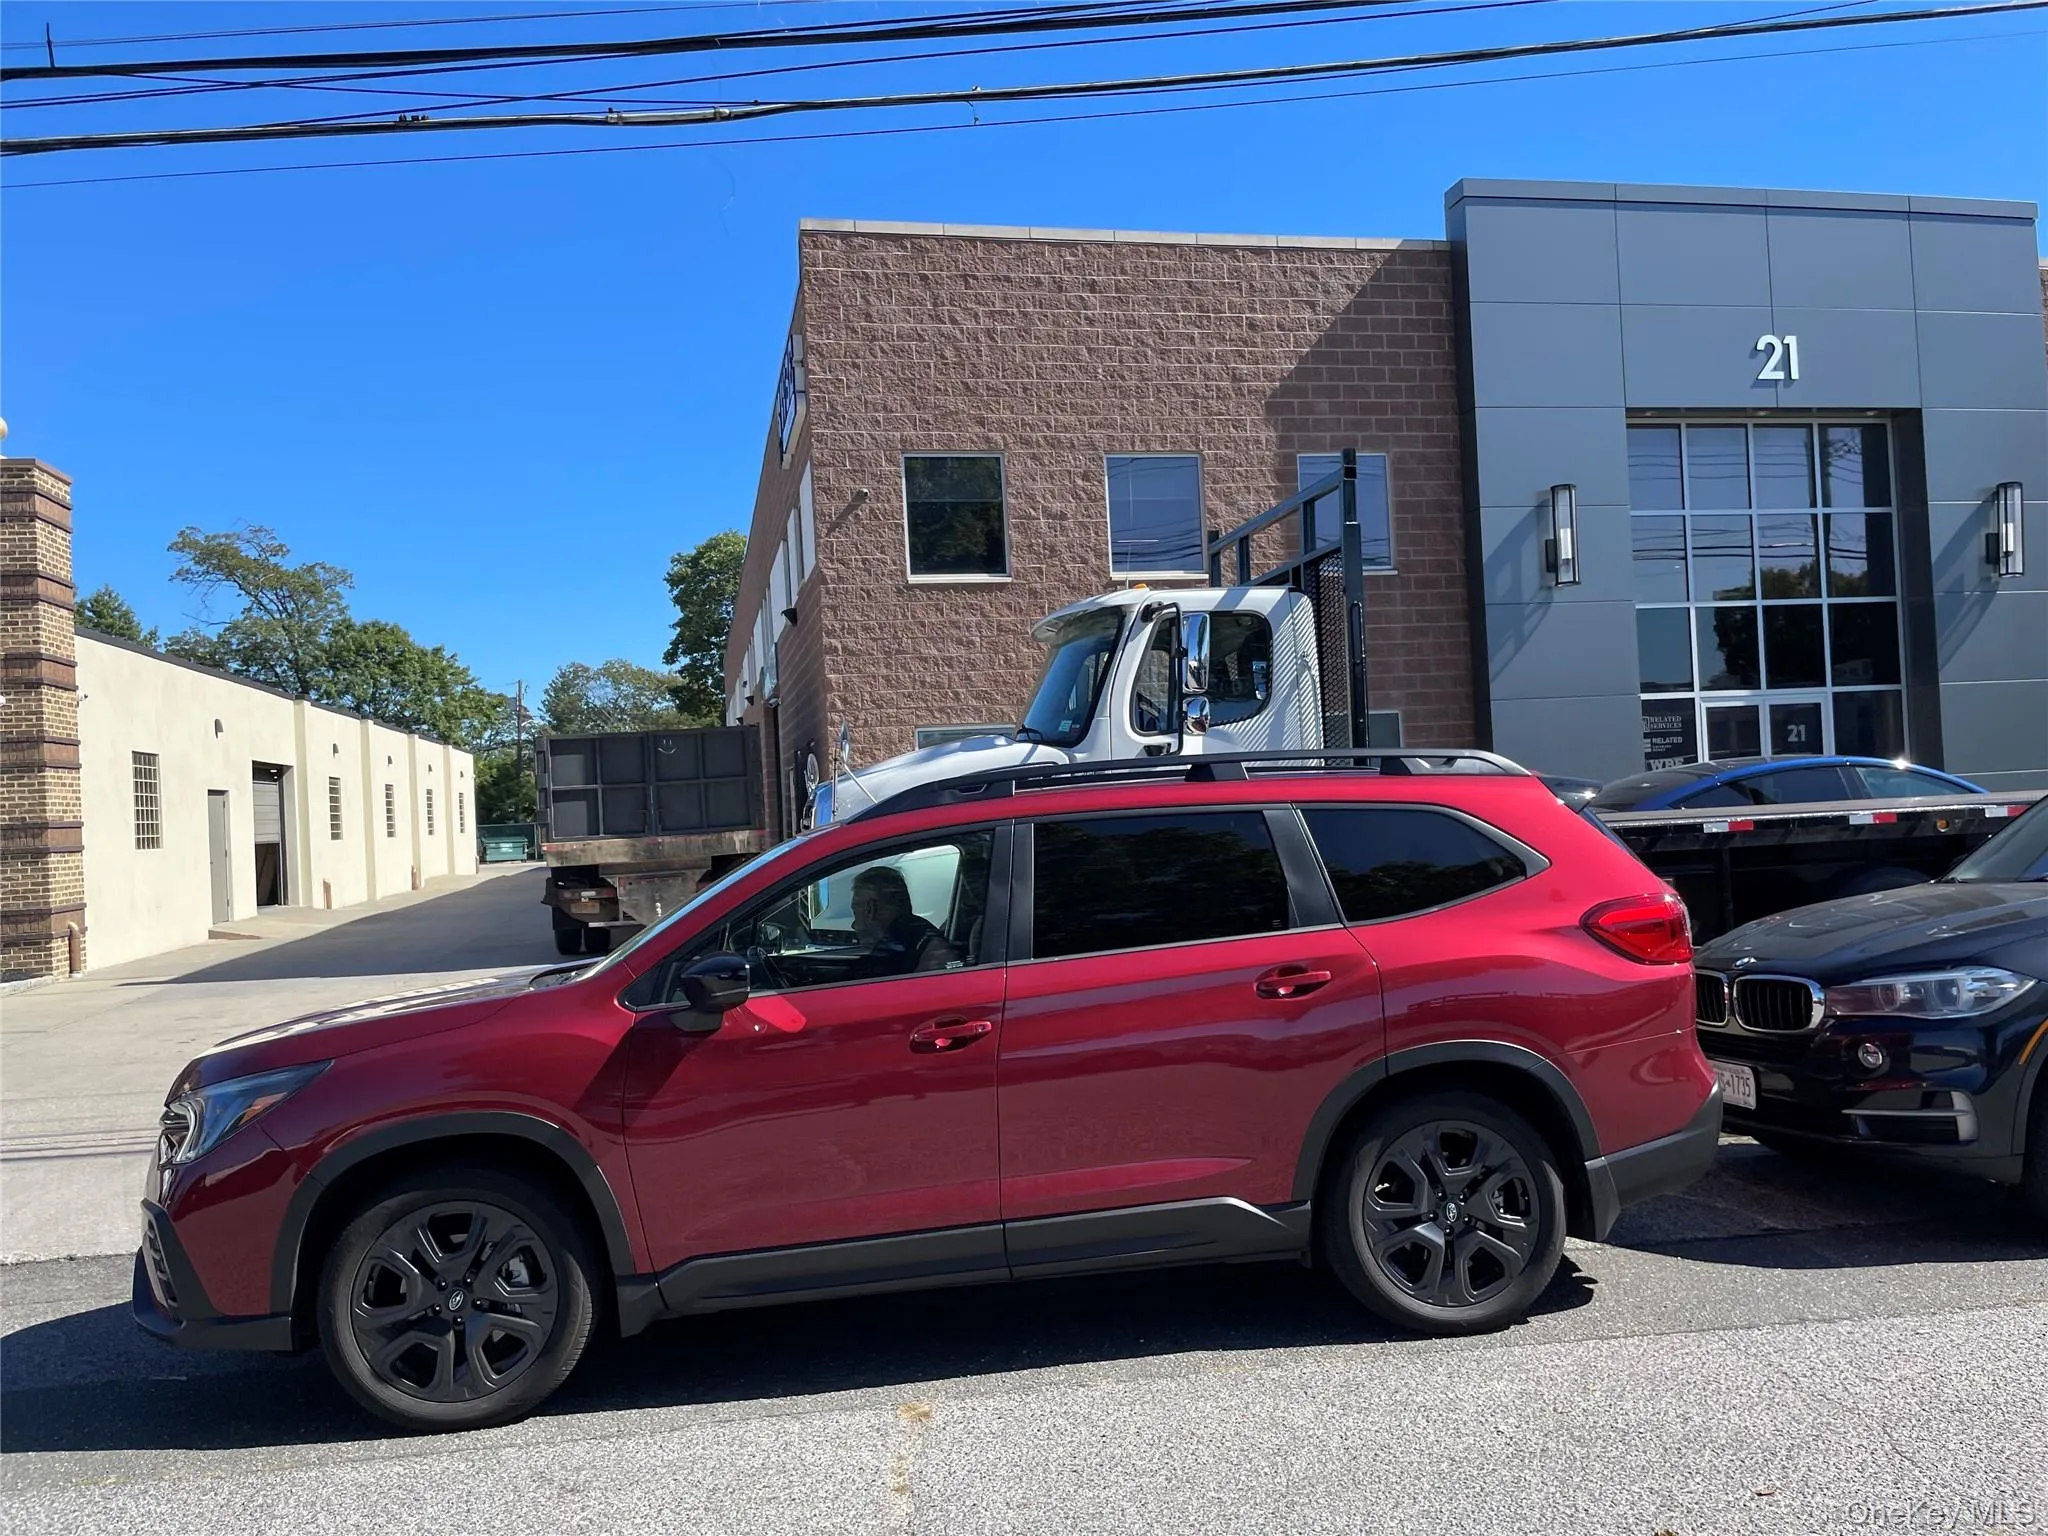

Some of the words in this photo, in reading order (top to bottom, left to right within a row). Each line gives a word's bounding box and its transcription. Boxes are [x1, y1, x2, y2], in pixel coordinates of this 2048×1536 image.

[1755, 334, 1800, 380] 21
[1652, 736, 1683, 744] RELATED
[1787, 724, 1806, 742] 21
